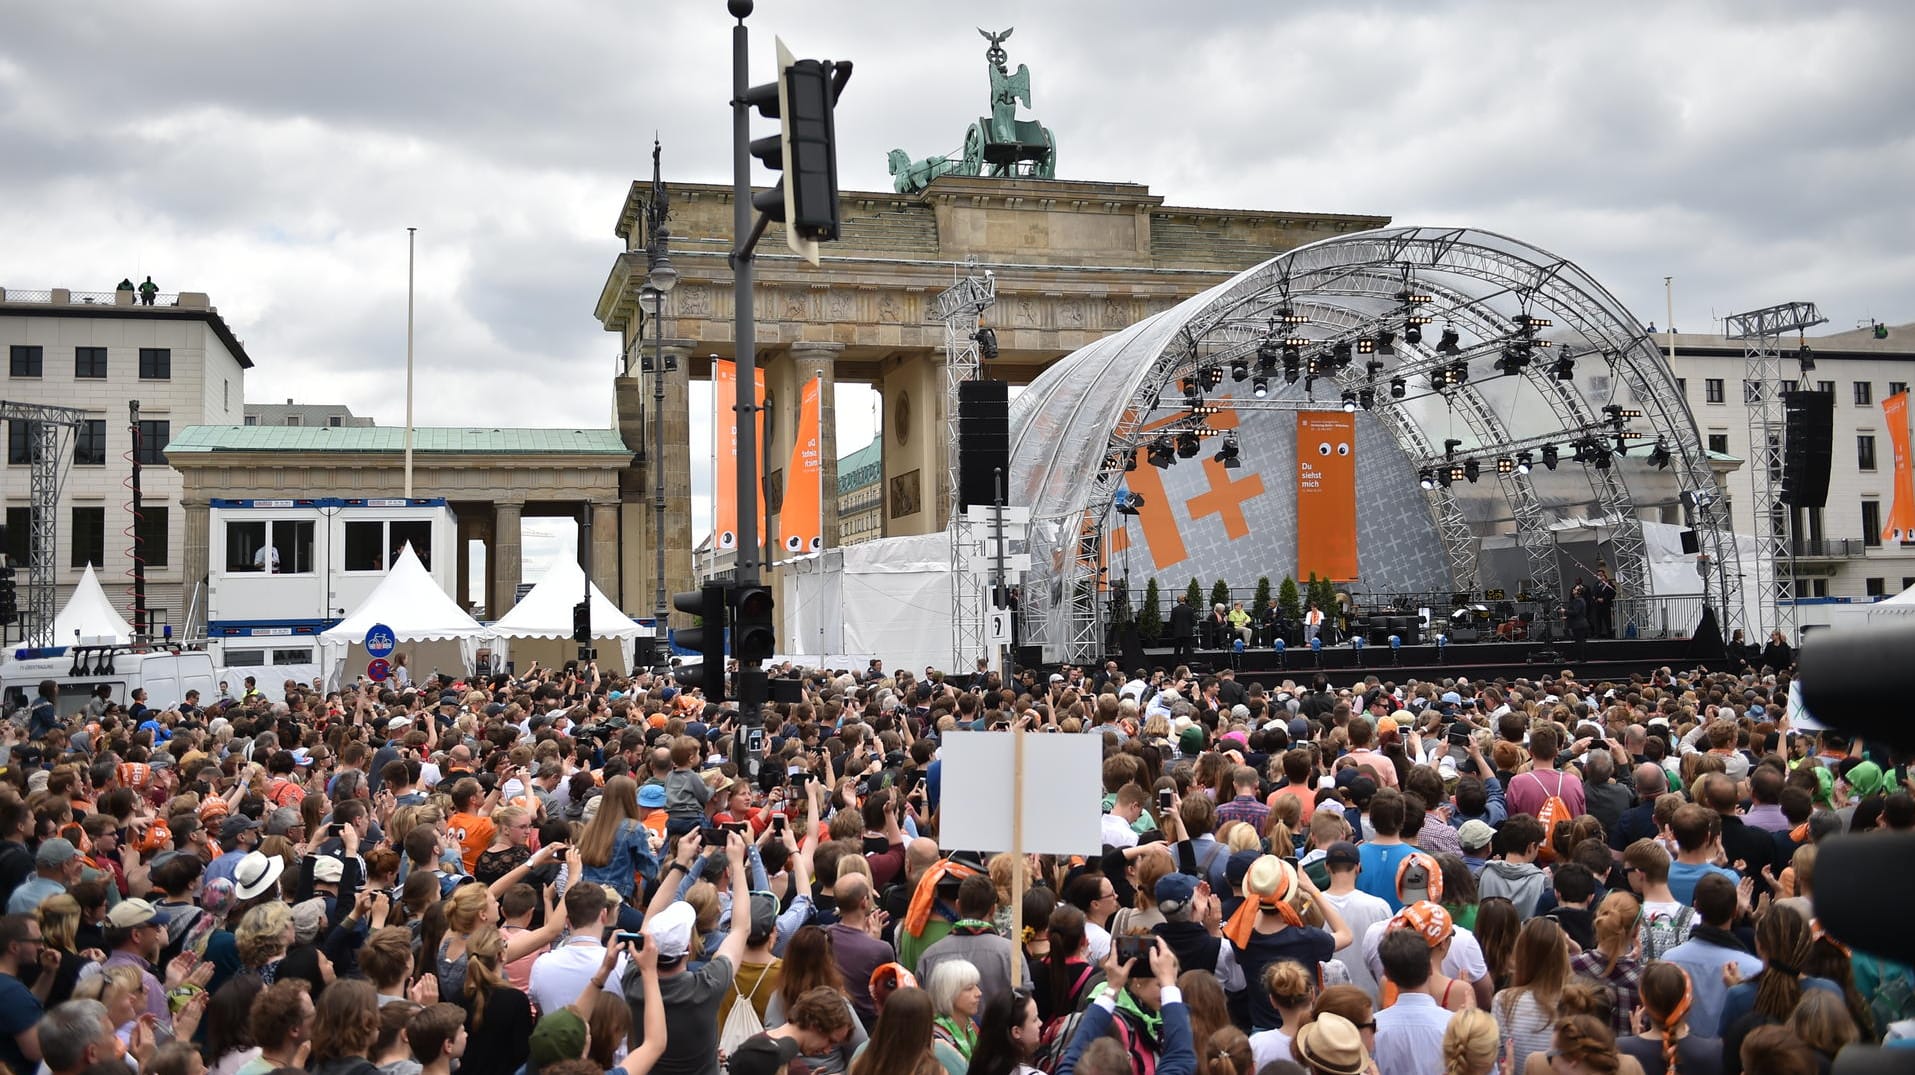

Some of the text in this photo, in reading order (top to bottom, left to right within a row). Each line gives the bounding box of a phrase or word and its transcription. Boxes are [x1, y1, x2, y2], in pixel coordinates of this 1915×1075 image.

[1301, 462, 1312, 470] Du
[1301, 471, 1322, 479] siehst
[1301, 480, 1320, 488] mich
